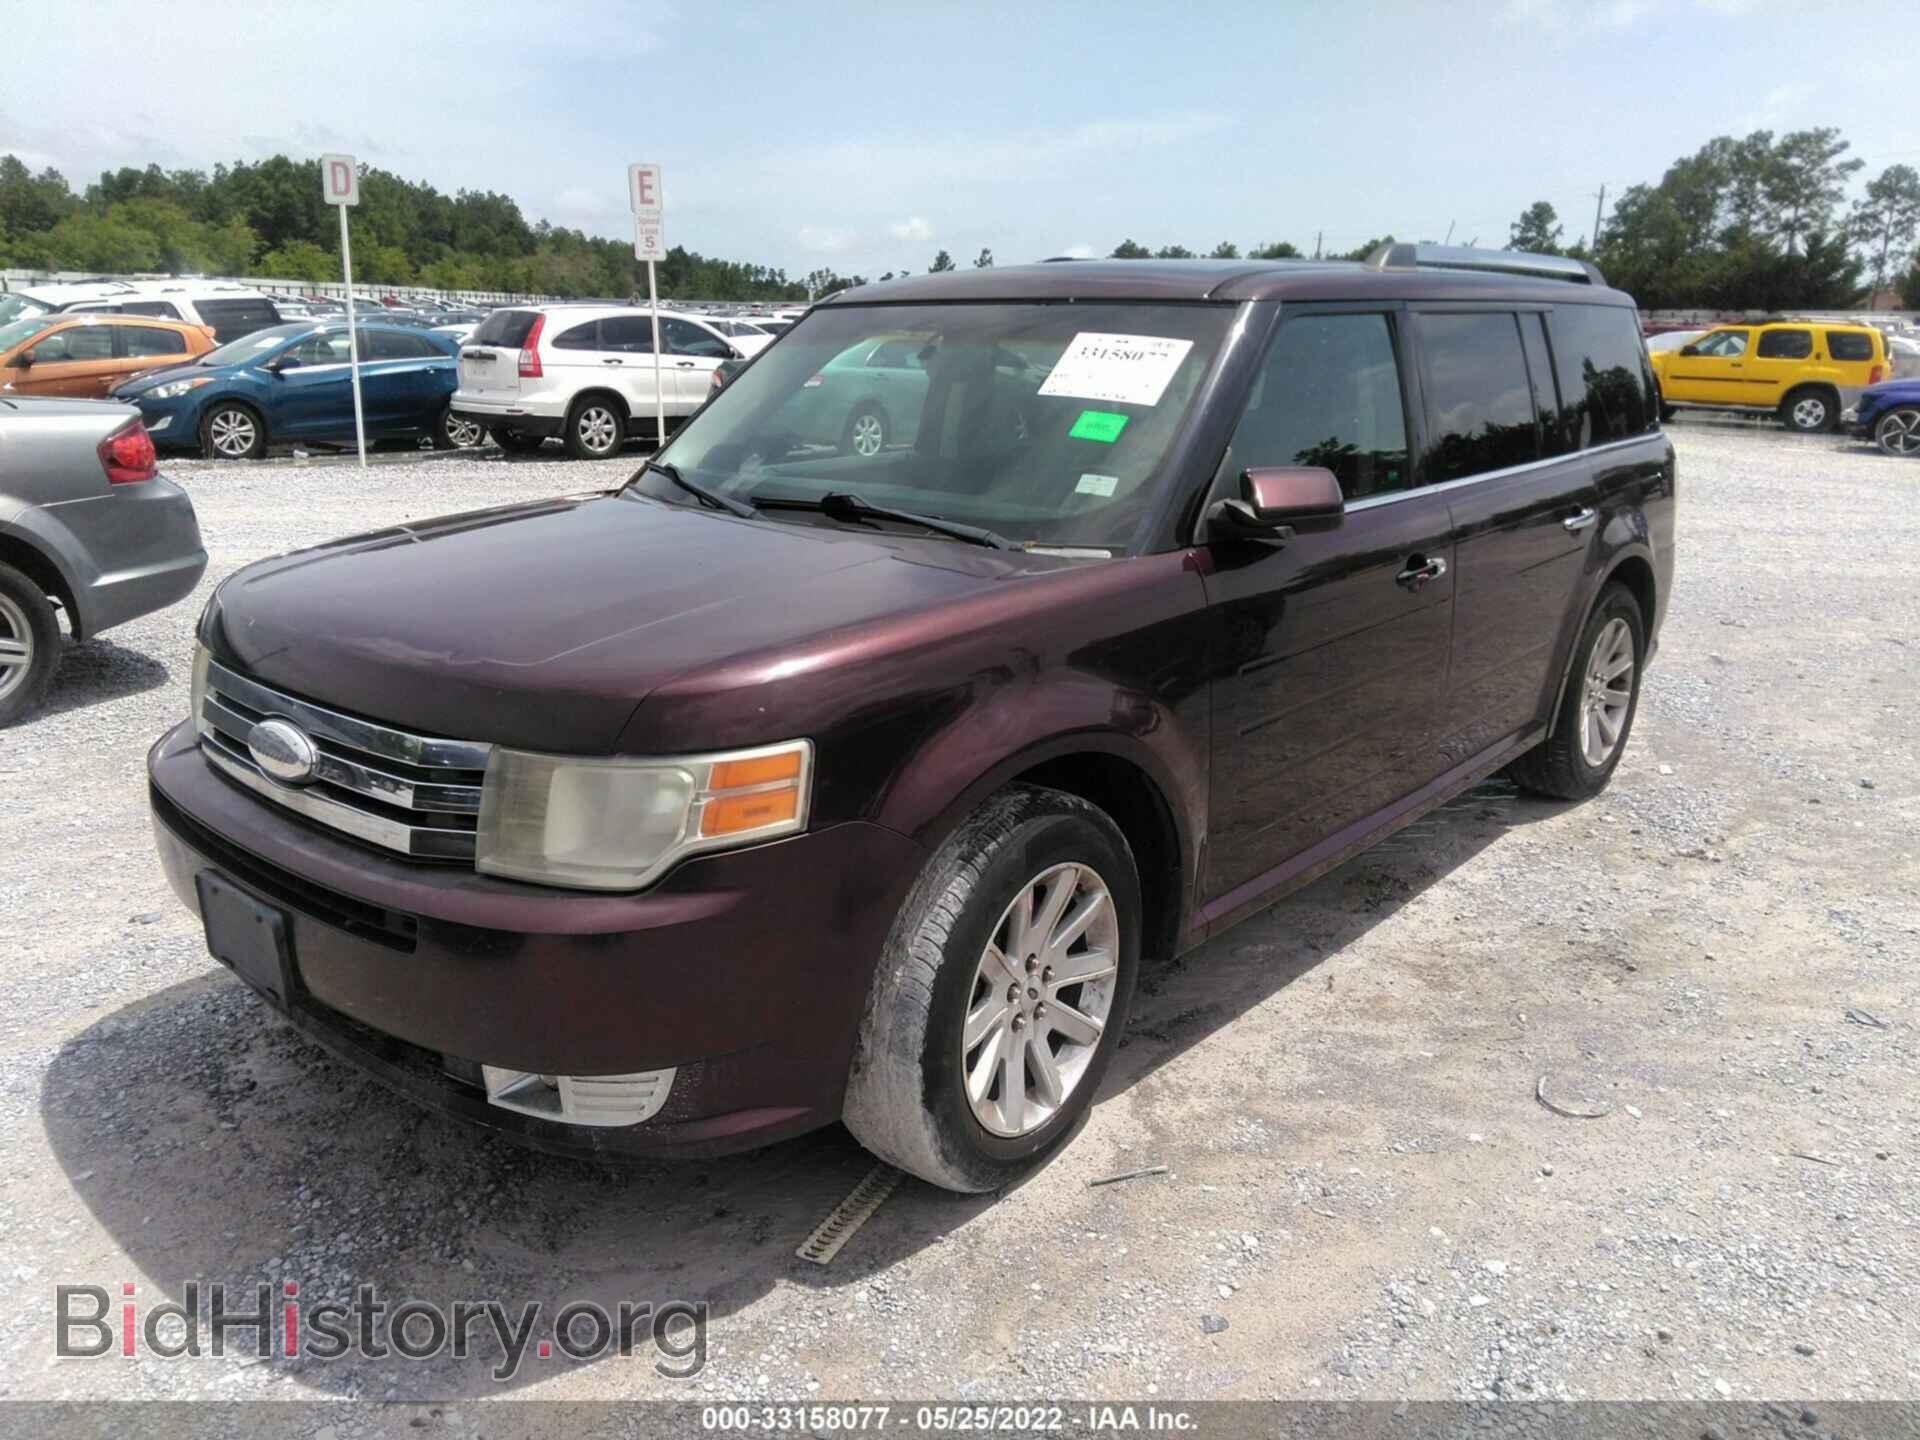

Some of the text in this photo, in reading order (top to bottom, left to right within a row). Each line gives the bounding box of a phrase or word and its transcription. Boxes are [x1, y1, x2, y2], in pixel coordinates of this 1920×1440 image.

[330, 161, 351, 196] D
[637, 170, 655, 205] E
[645, 235, 655, 249] 5
